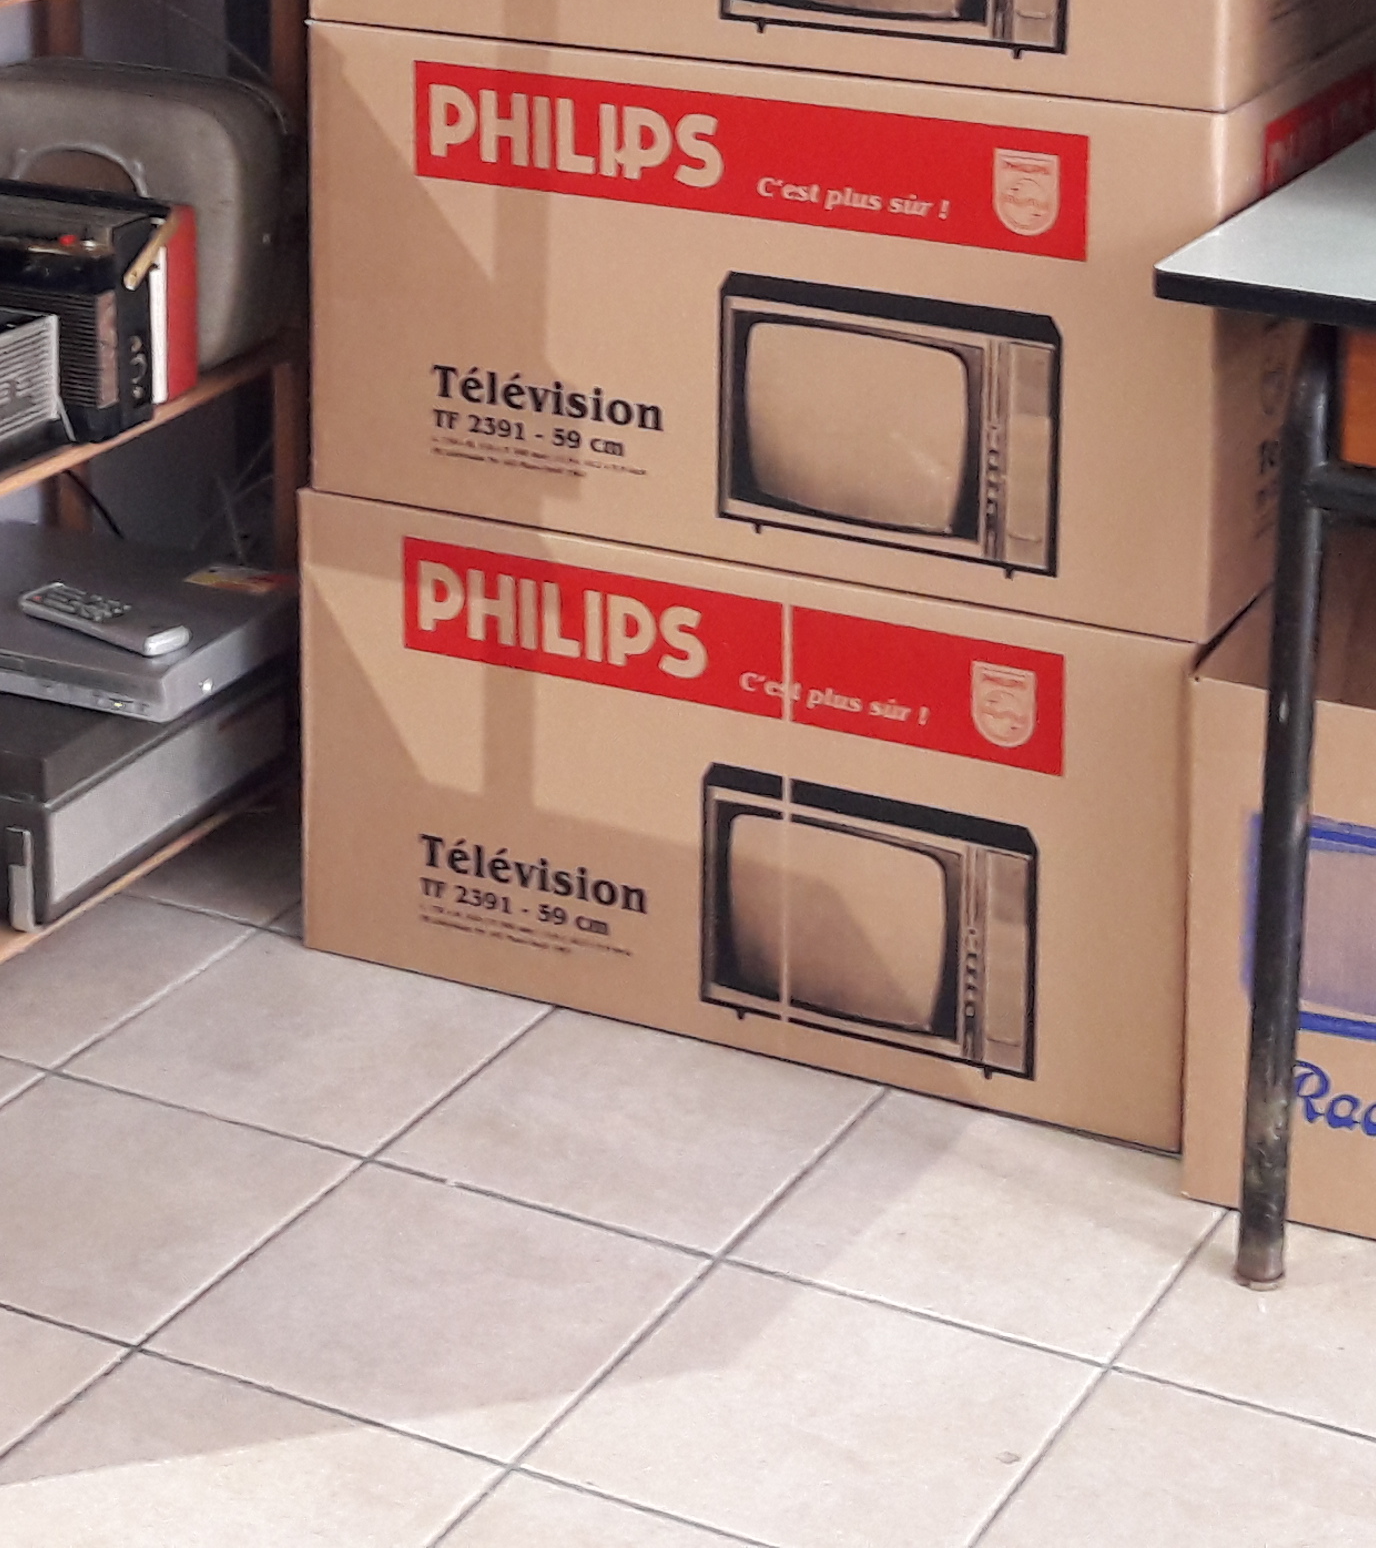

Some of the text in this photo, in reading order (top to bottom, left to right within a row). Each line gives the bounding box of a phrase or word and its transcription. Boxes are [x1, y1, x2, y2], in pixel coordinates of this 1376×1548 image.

[428, 83, 724, 189] PHILIPS
[756, 177, 820, 203] C'est
[824, 187, 882, 211] plus
[938, 200, 950, 220] !
[432, 408, 460, 430] TF
[468, 413, 526, 441] 2391
[552, 426, 582, 449] 59
[590, 437, 625, 457] cm
[433, 364, 665, 431] Télévision
[417, 561, 708, 680] PHILIPS
[739, 671, 802, 702] C'et
[805, 687, 864, 713] plus
[918, 705, 930, 726] !
[419, 833, 648, 915] Télévision
[454, 883, 513, 915] 2391
[537, 902, 568, 926] 59
